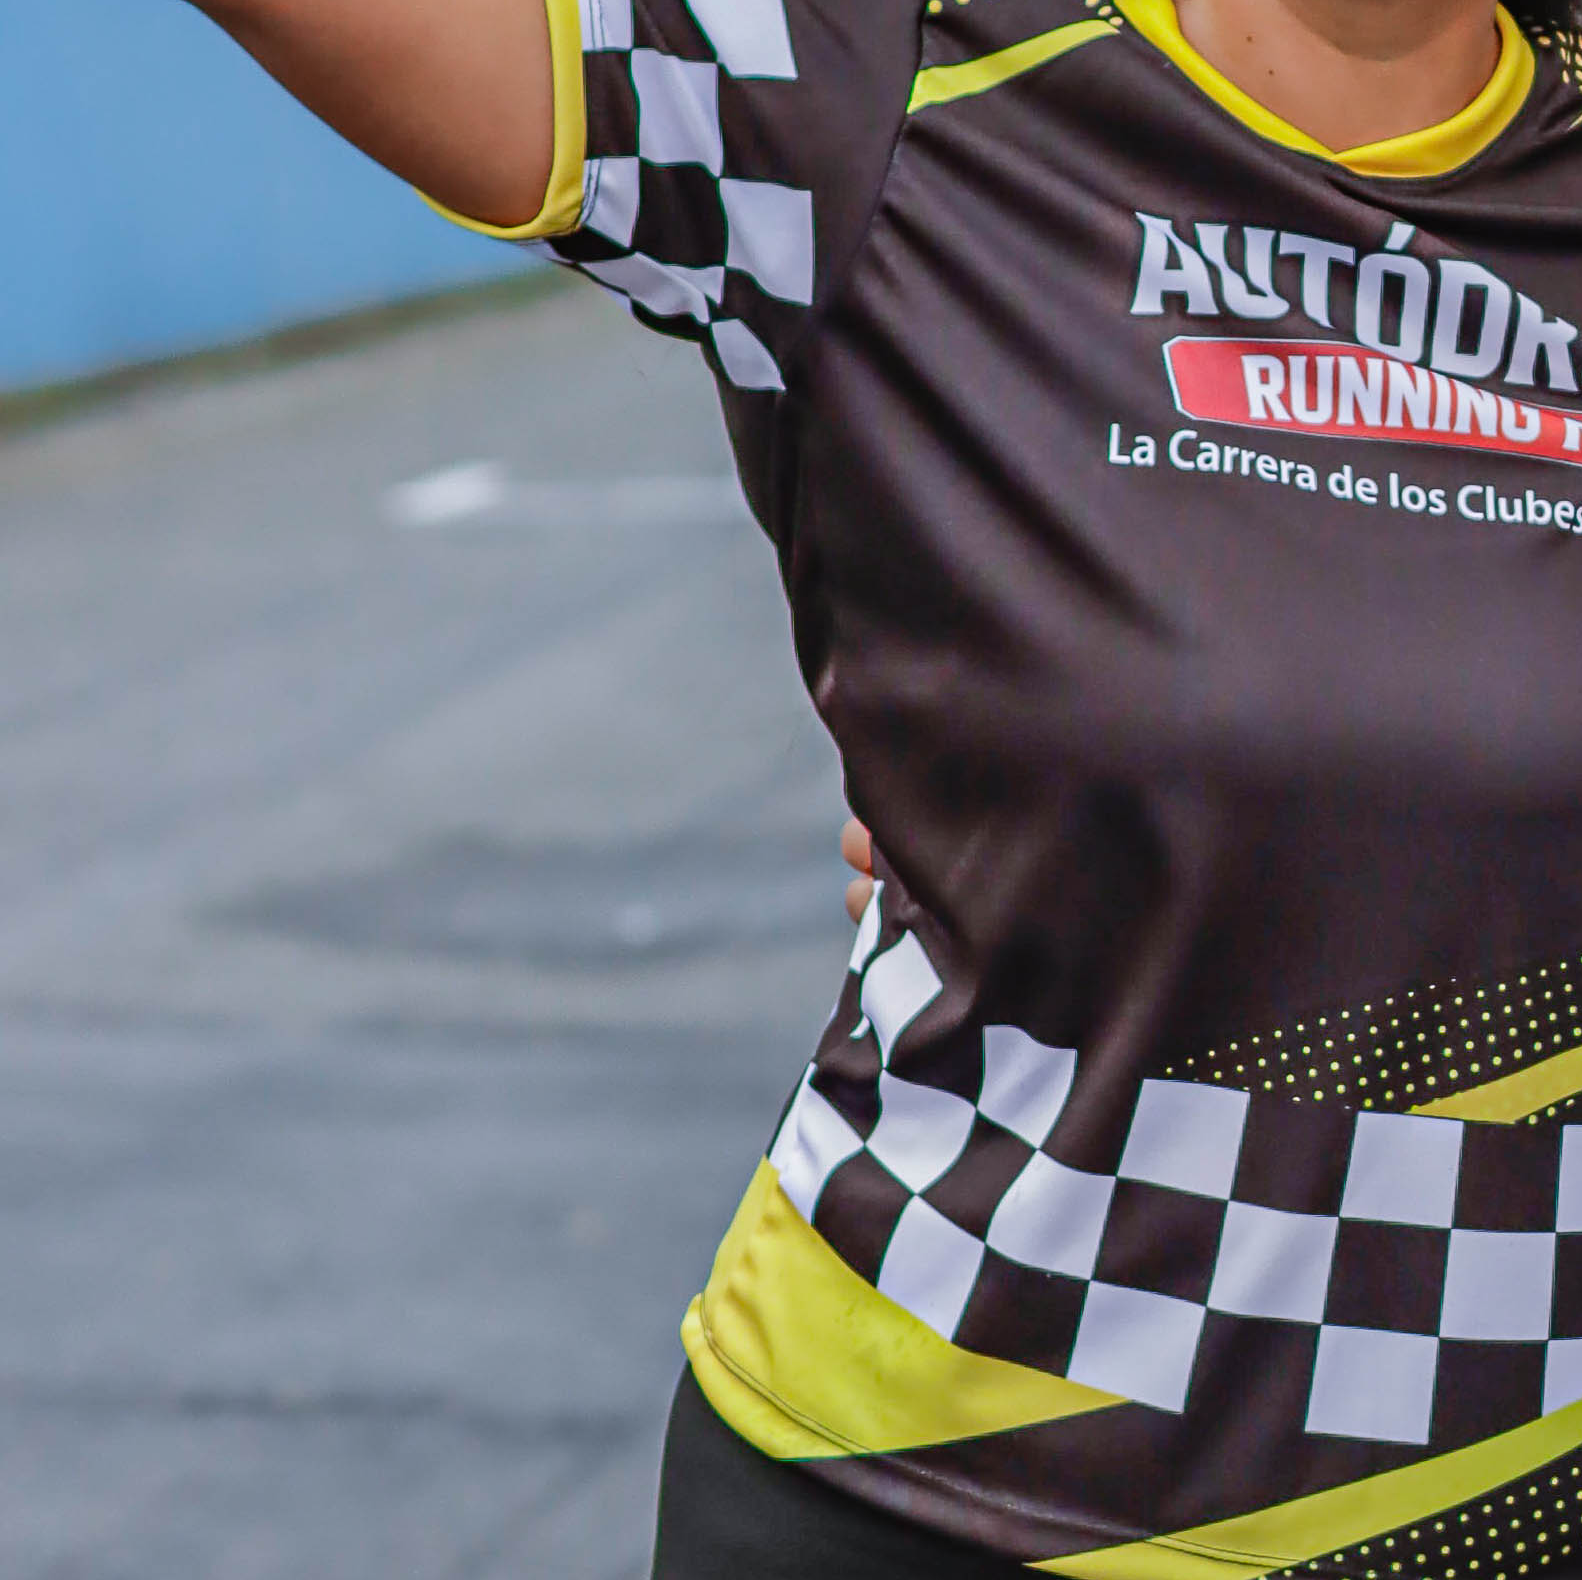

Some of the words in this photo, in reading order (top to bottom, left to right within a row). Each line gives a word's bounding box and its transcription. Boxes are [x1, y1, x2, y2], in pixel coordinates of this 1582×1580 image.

[1240, 353, 1541, 440] RUNNING
[1107, 423, 1155, 467] La
[1168, 428, 1318, 492] Carrera
[1327, 463, 1378, 504] de
[1389, 472, 1447, 516] los
